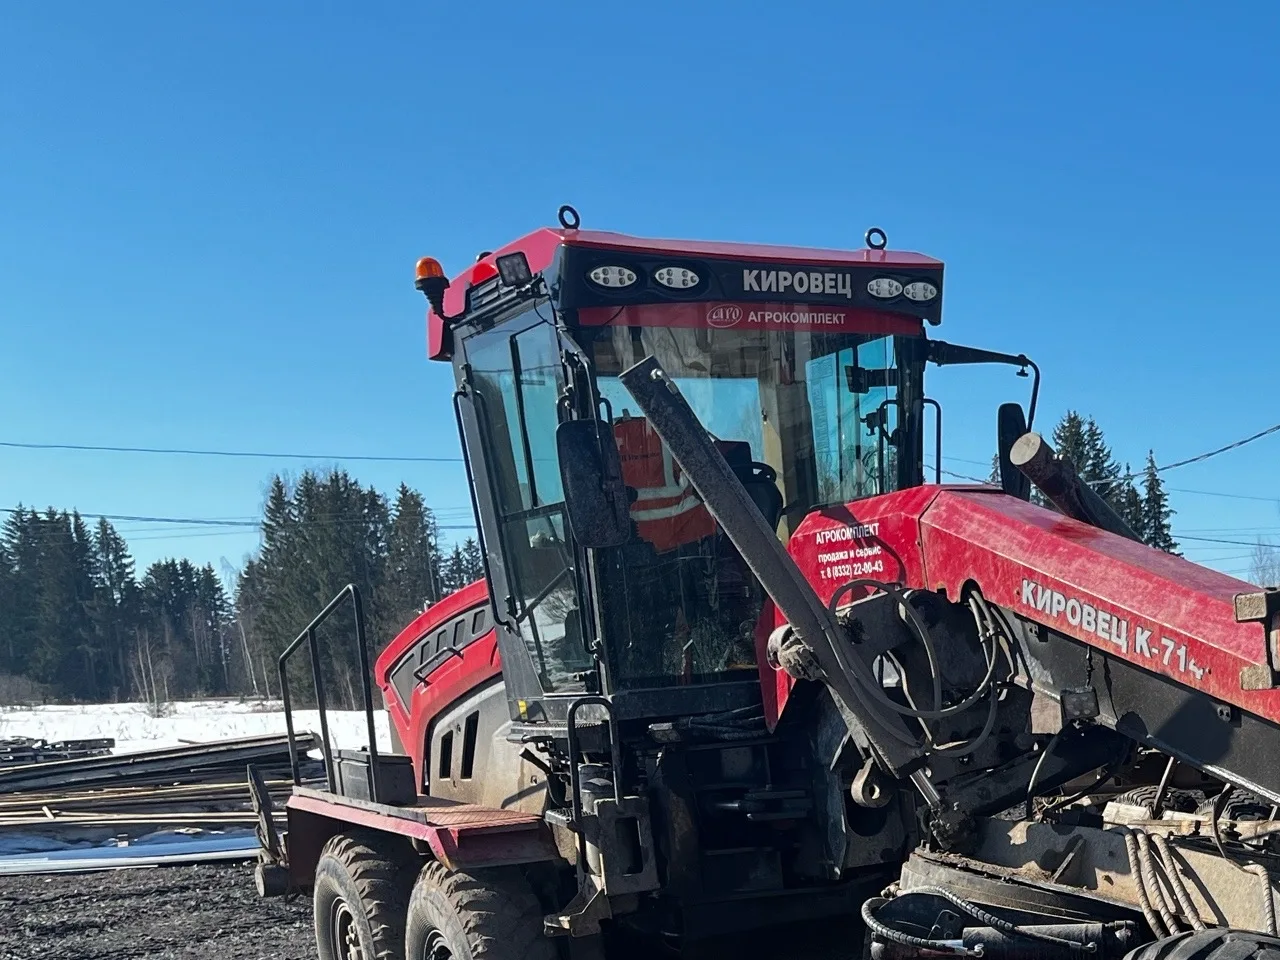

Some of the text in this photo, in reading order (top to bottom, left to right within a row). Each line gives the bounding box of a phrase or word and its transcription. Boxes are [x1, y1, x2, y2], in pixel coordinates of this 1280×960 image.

[743, 269, 852, 299] КИРОВЕЦ
[747, 311, 846, 325] АГРОКОМПЛЕКТ
[816, 523, 880, 545] АГРОКОМПЛЕКТ
[818, 546, 882, 565] продажа и сервис
[832, 564, 852, 580] (8332)
[853, 559, 884, 576] 22-00-43
[1022, 578, 1129, 654] КИРОВЕЦ
